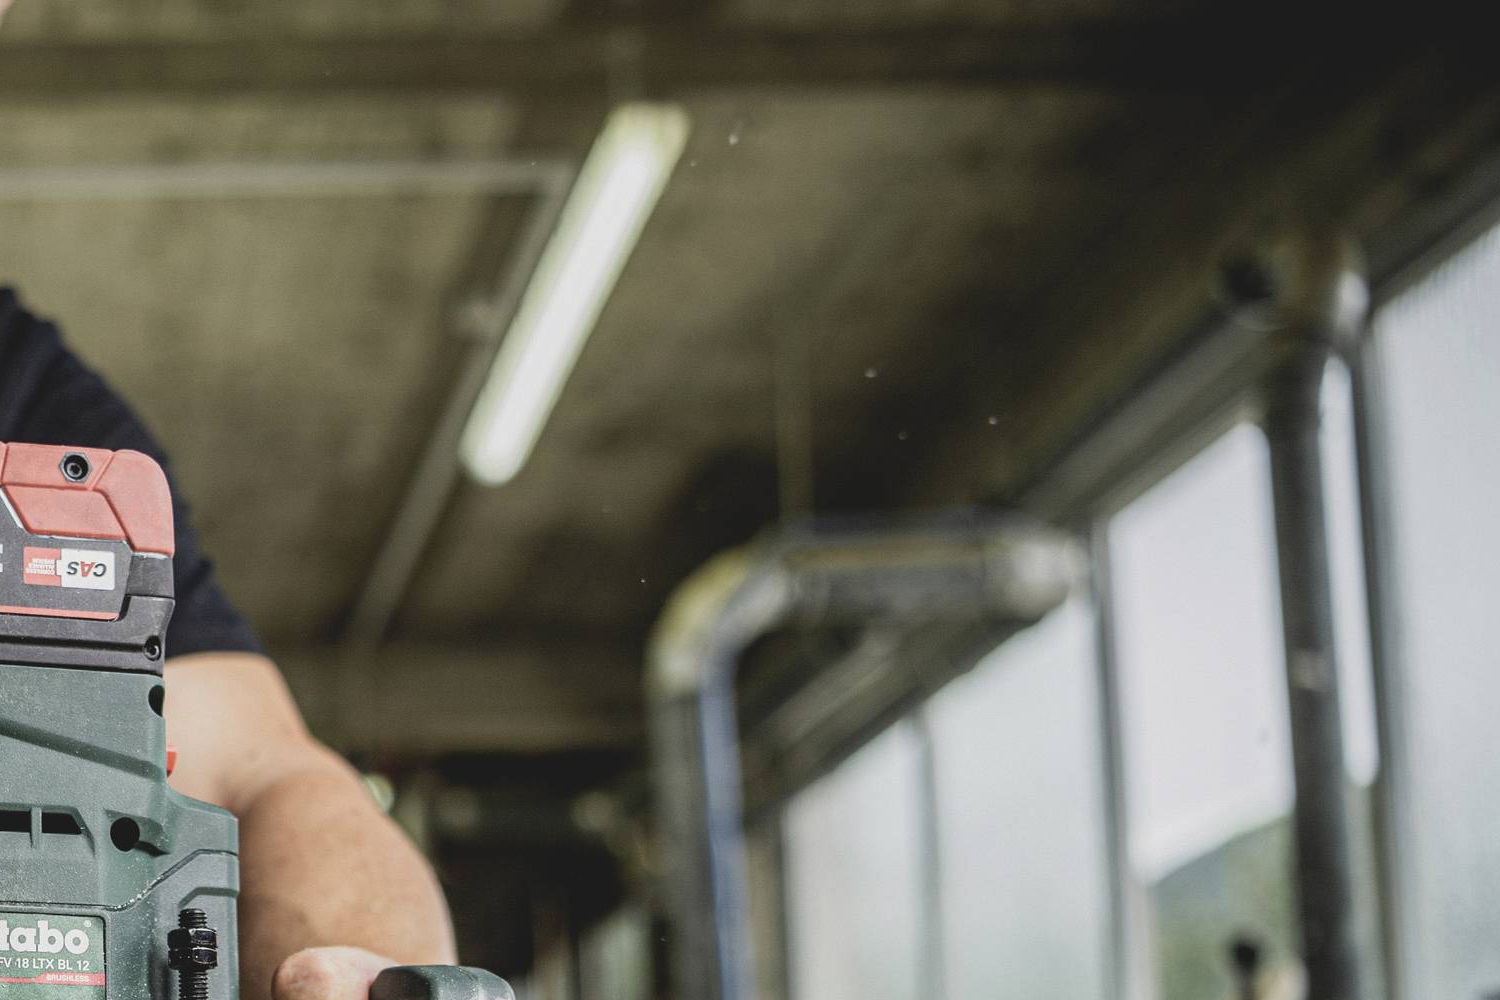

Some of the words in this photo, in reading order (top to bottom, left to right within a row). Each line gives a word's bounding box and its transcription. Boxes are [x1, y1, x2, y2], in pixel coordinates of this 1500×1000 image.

[66, 560, 107, 577] CAS
[15, 957, 30, 969] 18
[32, 958, 55, 970] LTX
[57, 959, 73, 971] BL
[76, 960, 90, 971] 12
[46, 973, 90, 983] BRUSHLESS
